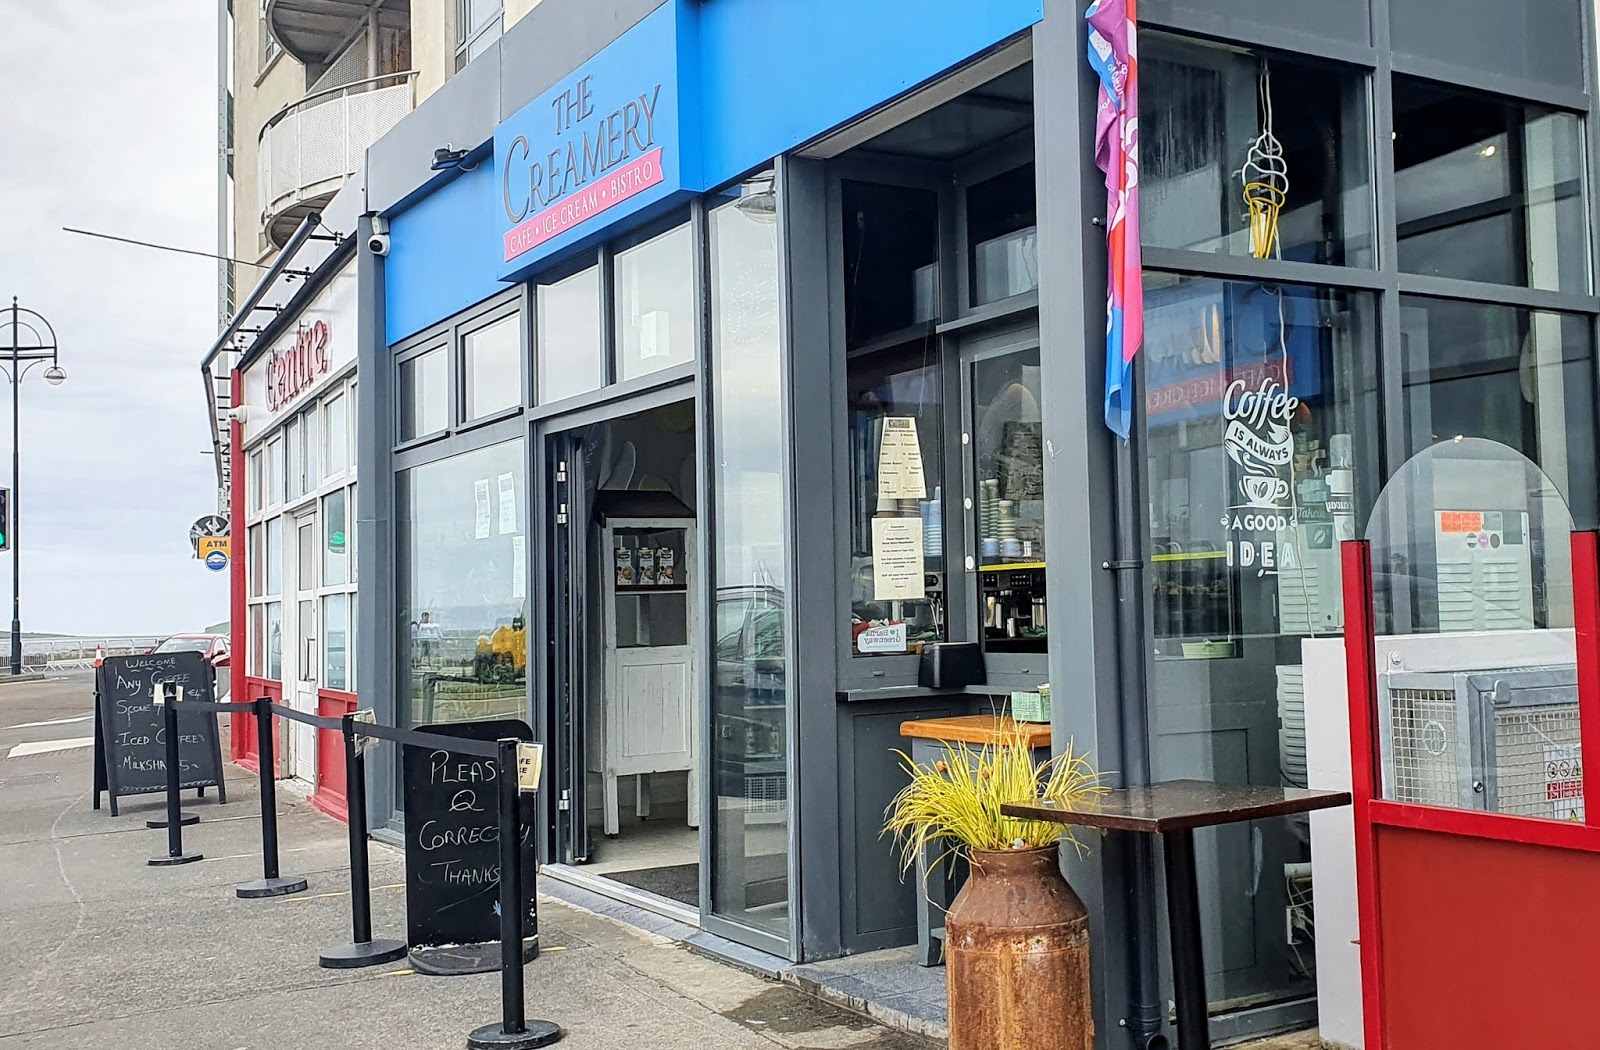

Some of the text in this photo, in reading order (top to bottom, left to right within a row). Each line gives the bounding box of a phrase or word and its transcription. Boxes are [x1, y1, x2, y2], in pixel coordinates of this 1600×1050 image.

[551, 74, 594, 136] THE
[503, 84, 662, 224] CREAMERY
[510, 161, 653, 253] CAFE ICE CREAM BISTRO
[264, 319, 328, 413] Centre
[1223, 377, 1299, 431] Coffee
[1233, 427, 1289, 461] IS ALWAYS
[1231, 514, 1287, 532] A GOOD
[206, 540, 227, 548] ATM
[1226, 540, 1296, 568] IDEA
[125, 657, 176, 669] WELCOME
[122, 755, 190, 772] MILKSHAS
[430, 750, 497, 785] PLEAS
[449, 789, 485, 812] Q
[431, 859, 501, 886] THANKS
